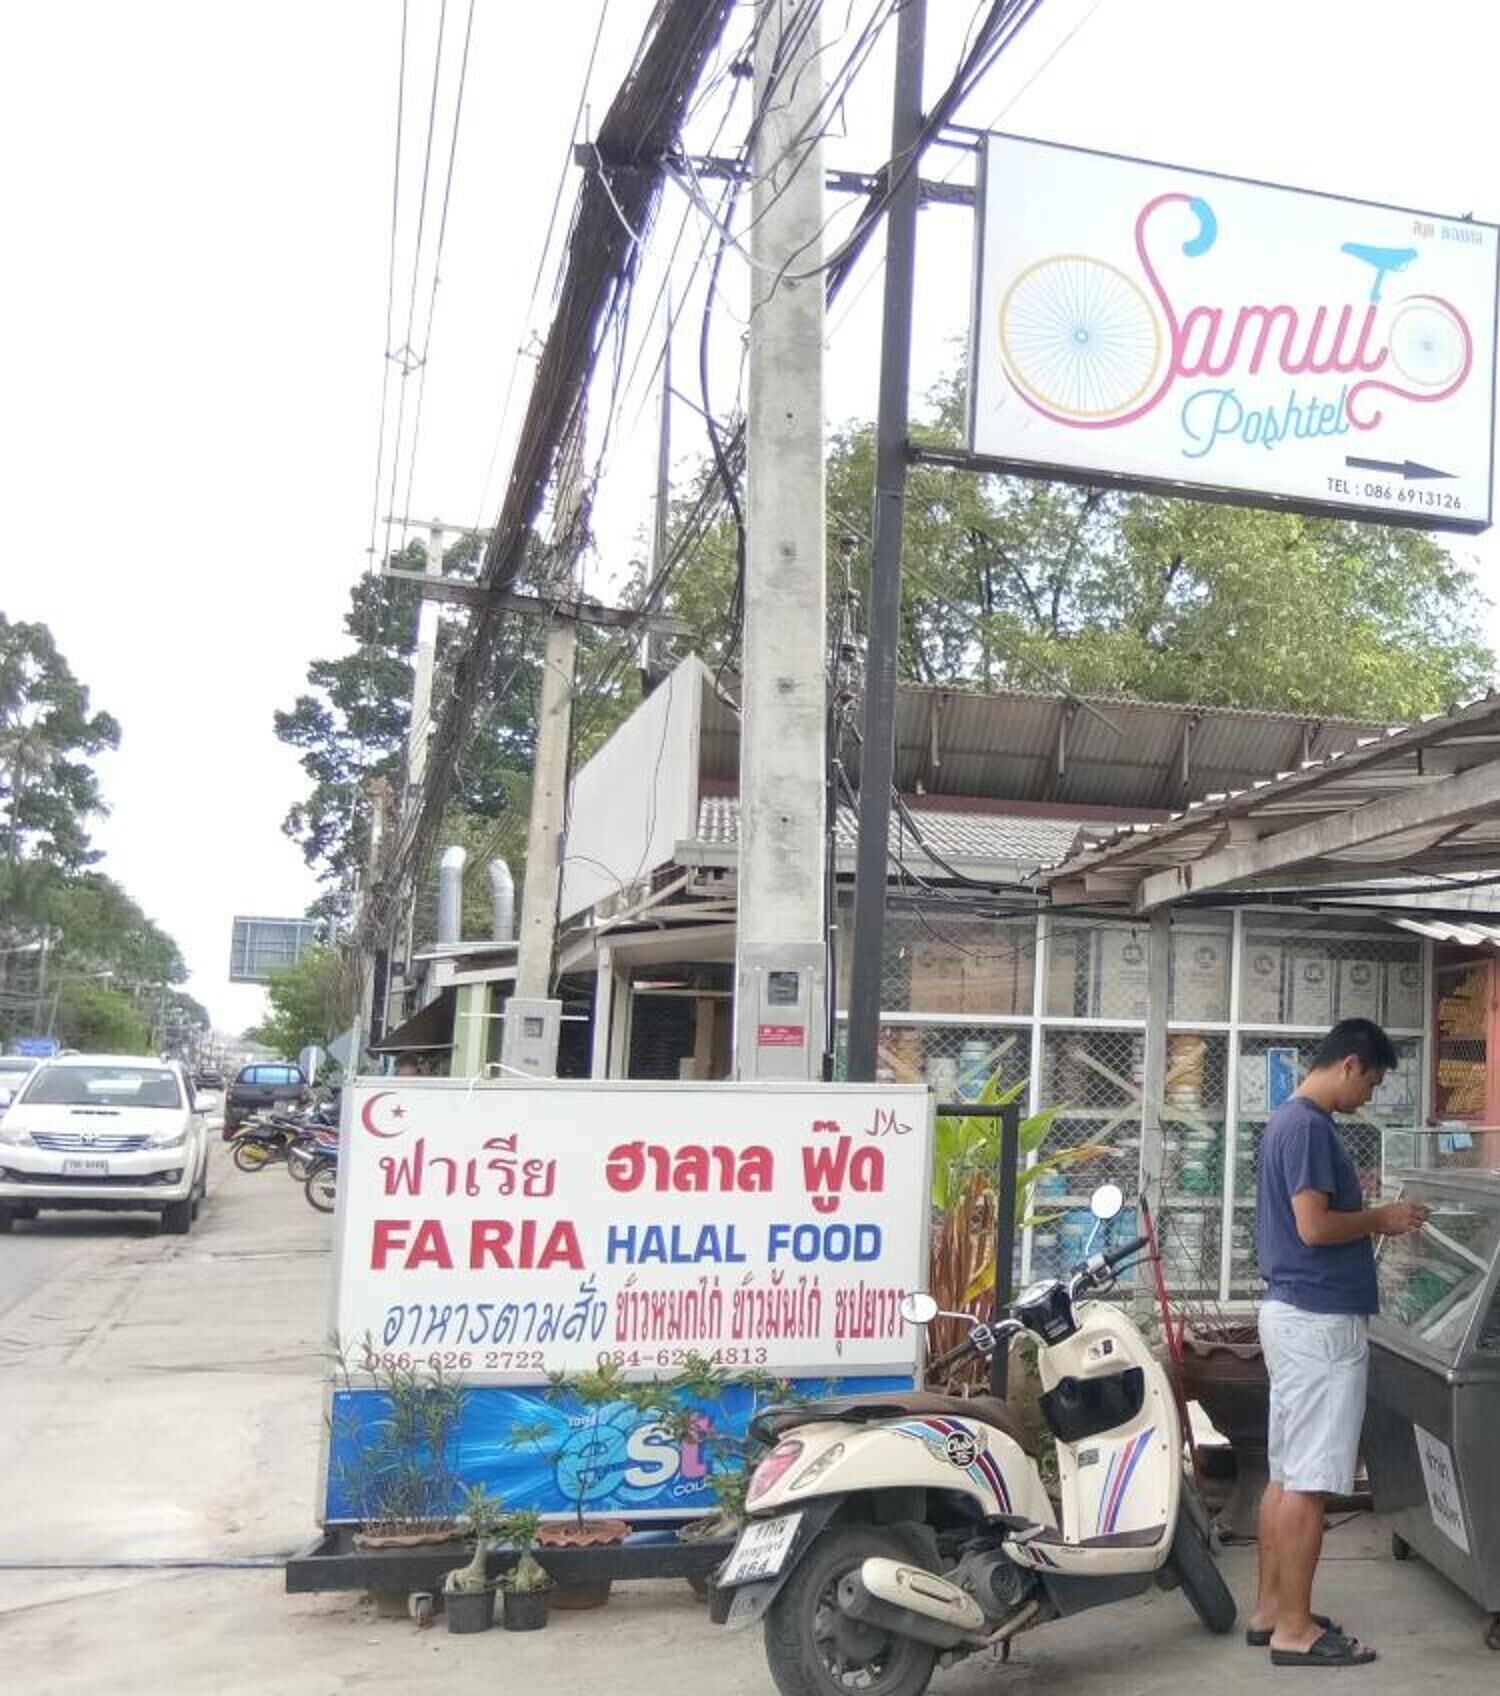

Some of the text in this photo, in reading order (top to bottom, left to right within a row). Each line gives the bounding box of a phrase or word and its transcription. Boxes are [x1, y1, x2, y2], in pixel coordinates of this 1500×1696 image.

[1181, 384, 1350, 458] Poshtel
[1364, 483, 1392, 500] 086
[1397, 489, 1462, 510] 6913126
[379, 1133, 558, 1199] ฟาเรีย
[605, 1140, 775, 1194] ฮาลาล
[606, 1225, 746, 1265] HALAL
[768, 1223, 883, 1264] FOOD
[383, 1274, 608, 1347] อาหารตามสั่ง
[614, 1273, 722, 1343] ข้าวหมกไก่
[485, 1350, 546, 1370] 2722
[712, 1347, 769, 1366] 4813
